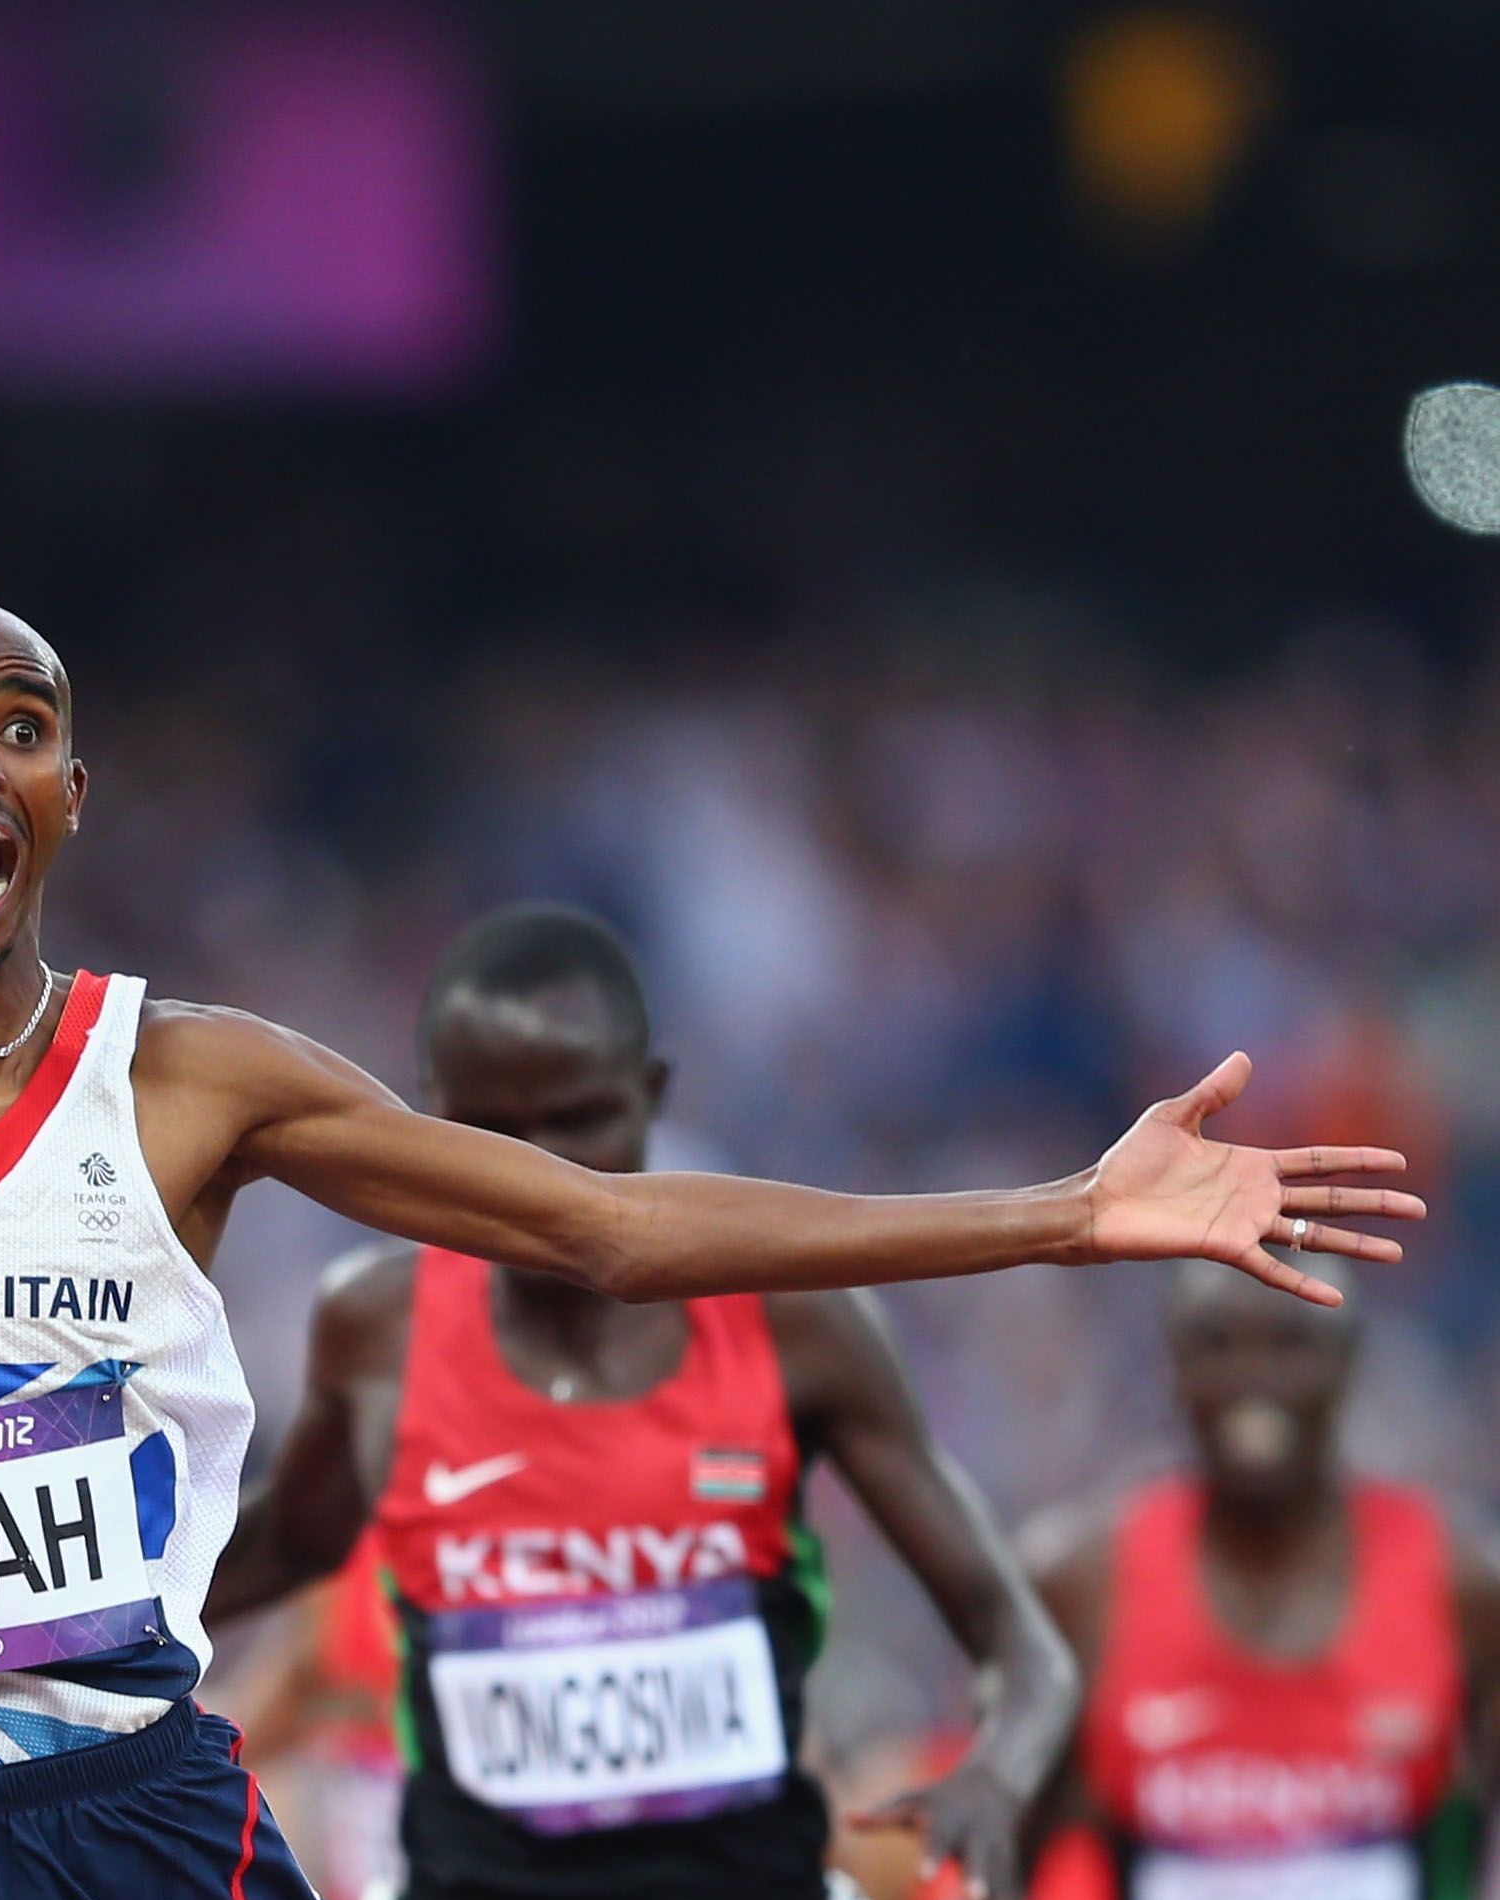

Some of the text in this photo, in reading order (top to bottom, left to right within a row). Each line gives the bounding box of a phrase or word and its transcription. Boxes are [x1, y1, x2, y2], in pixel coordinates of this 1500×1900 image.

[73, 1193, 127, 1206] TEAM GB
[434, 1519, 747, 1603] KENYA
